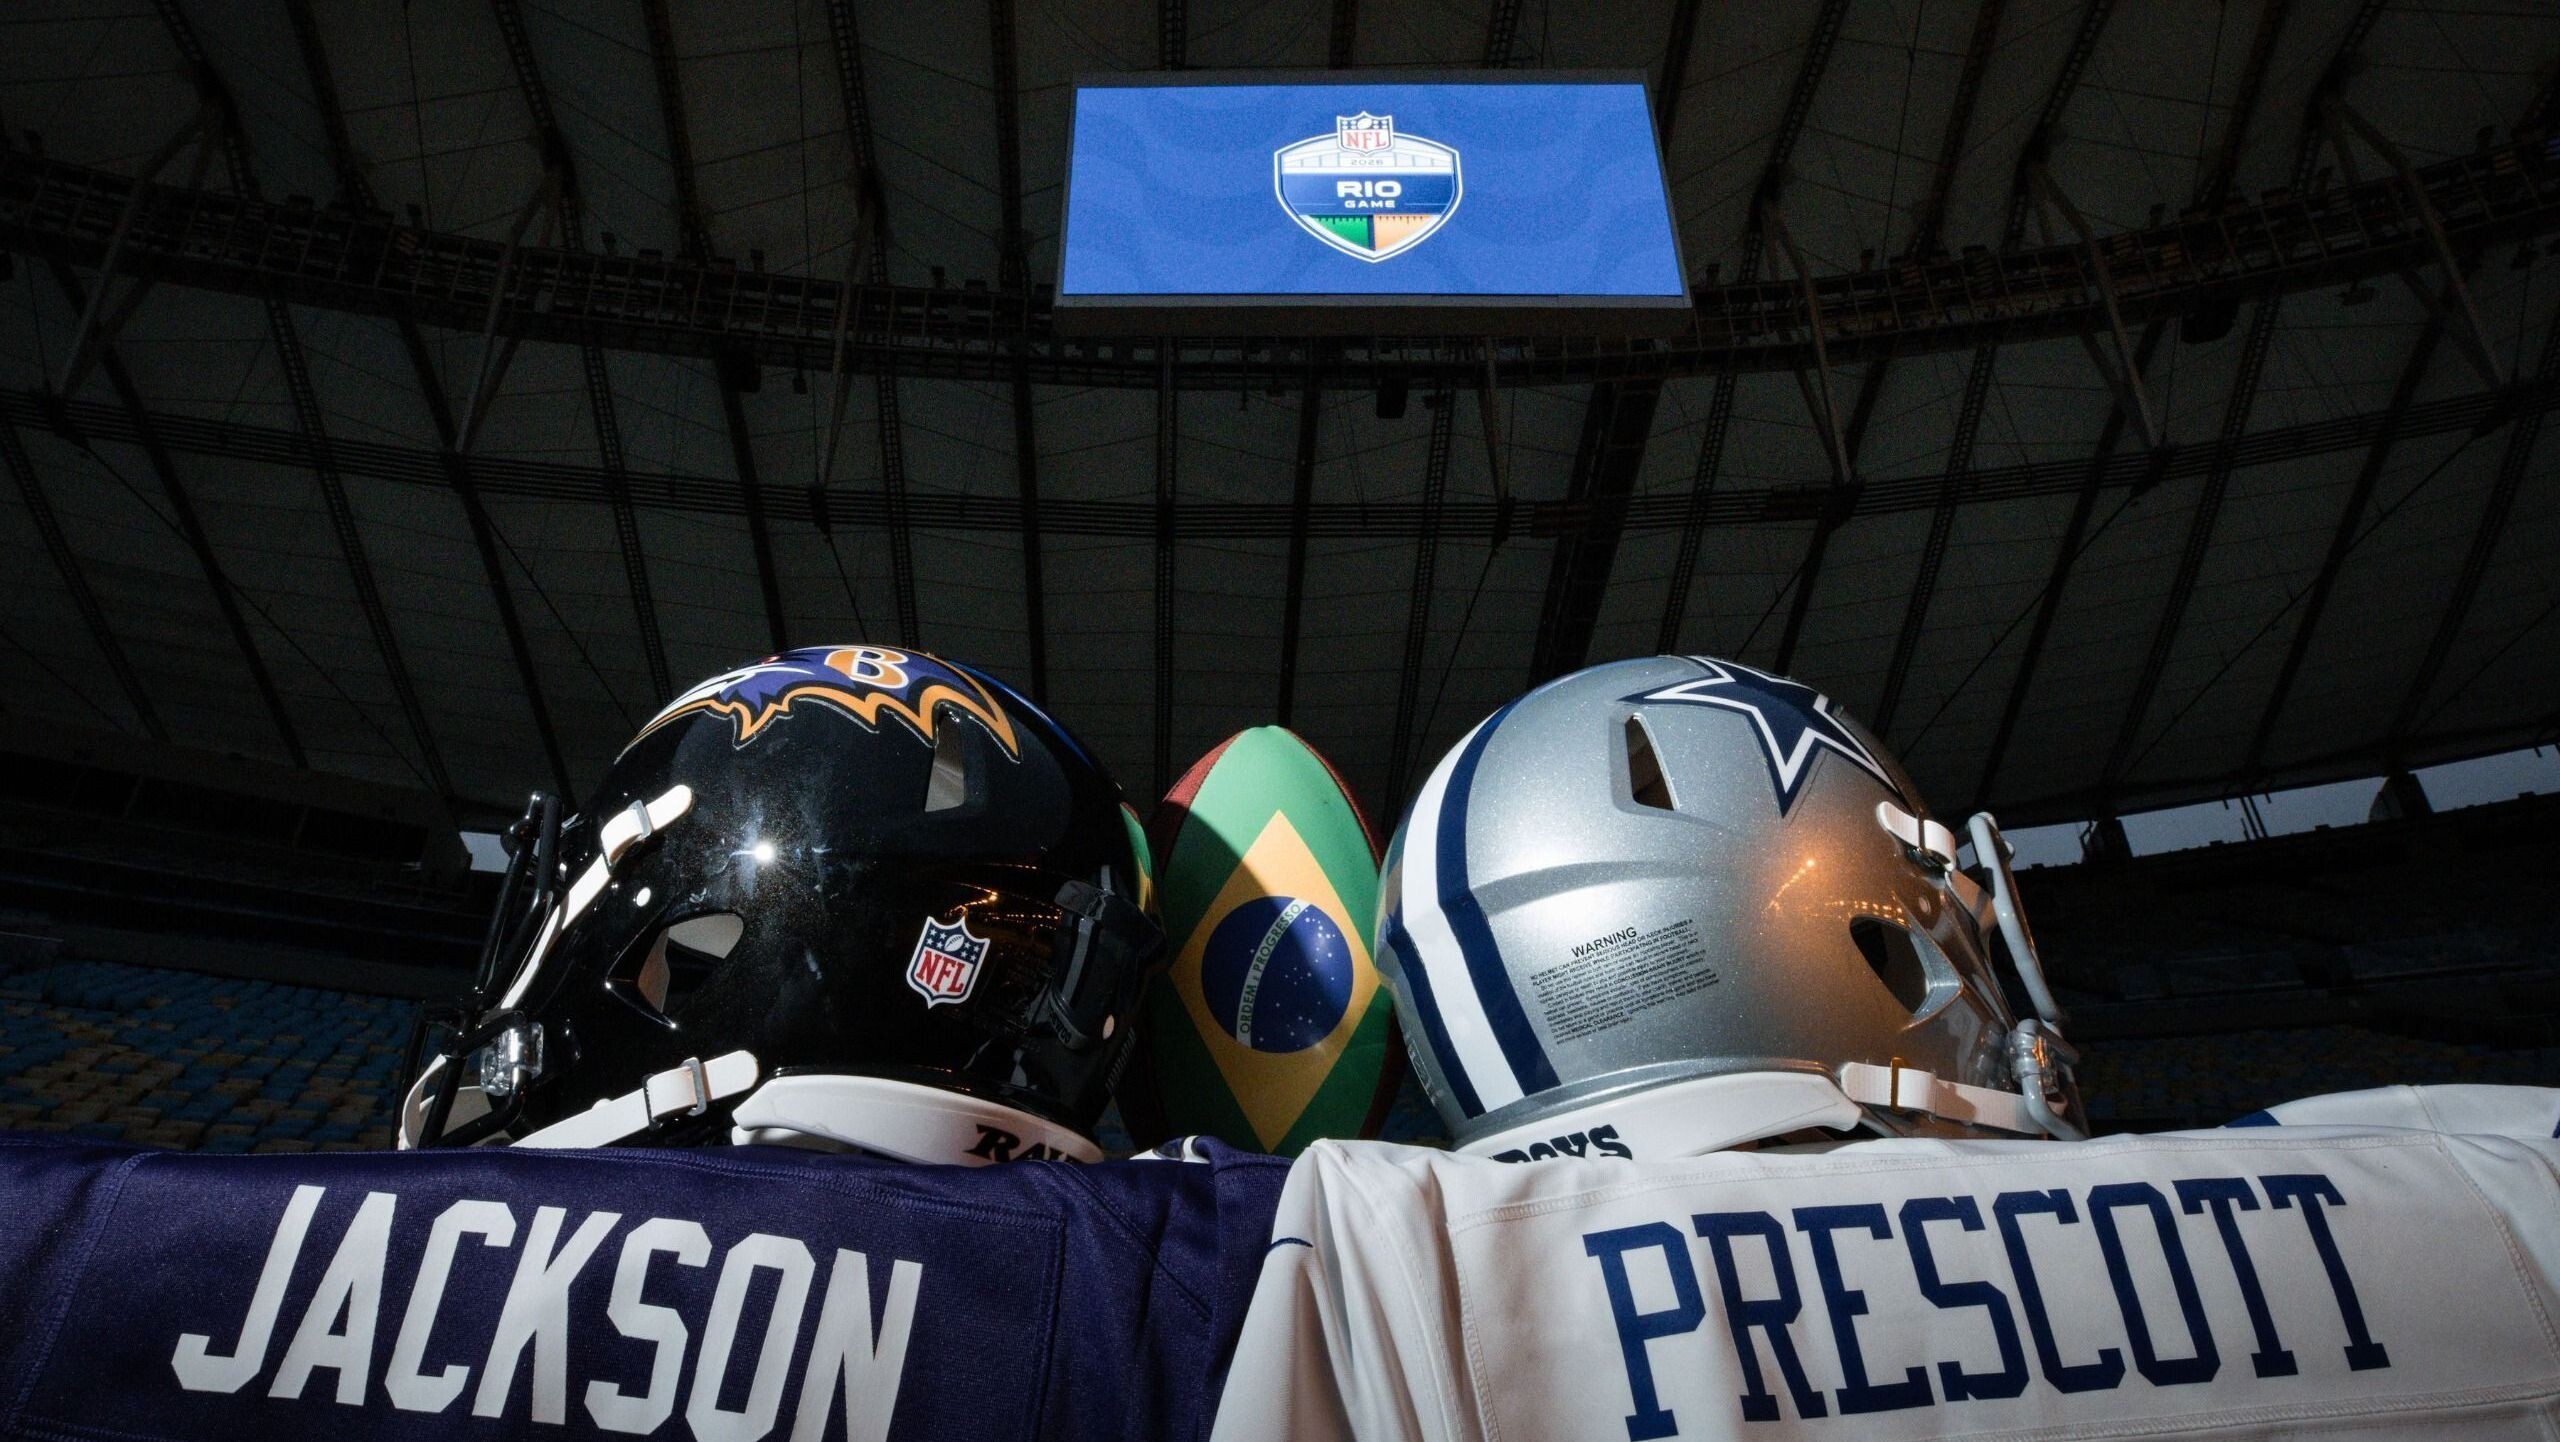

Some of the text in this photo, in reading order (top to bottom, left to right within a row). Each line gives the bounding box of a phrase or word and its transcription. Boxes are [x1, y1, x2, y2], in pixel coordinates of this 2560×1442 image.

[1346, 132, 1386, 149] NFL
[1337, 180, 1402, 198] RIO
[1344, 200, 1395, 208] GAME
[828, 646, 909, 689] B
[1571, 926, 1638, 958] WARNING
[915, 950, 967, 993] NFL
[1240, 984, 1257, 1034] ORDEM
[1253, 903, 1301, 972] PROGRESSO
[171, 1184, 924, 1442] JACKSON
[1581, 1173, 2392, 1442] PRESCOTT
